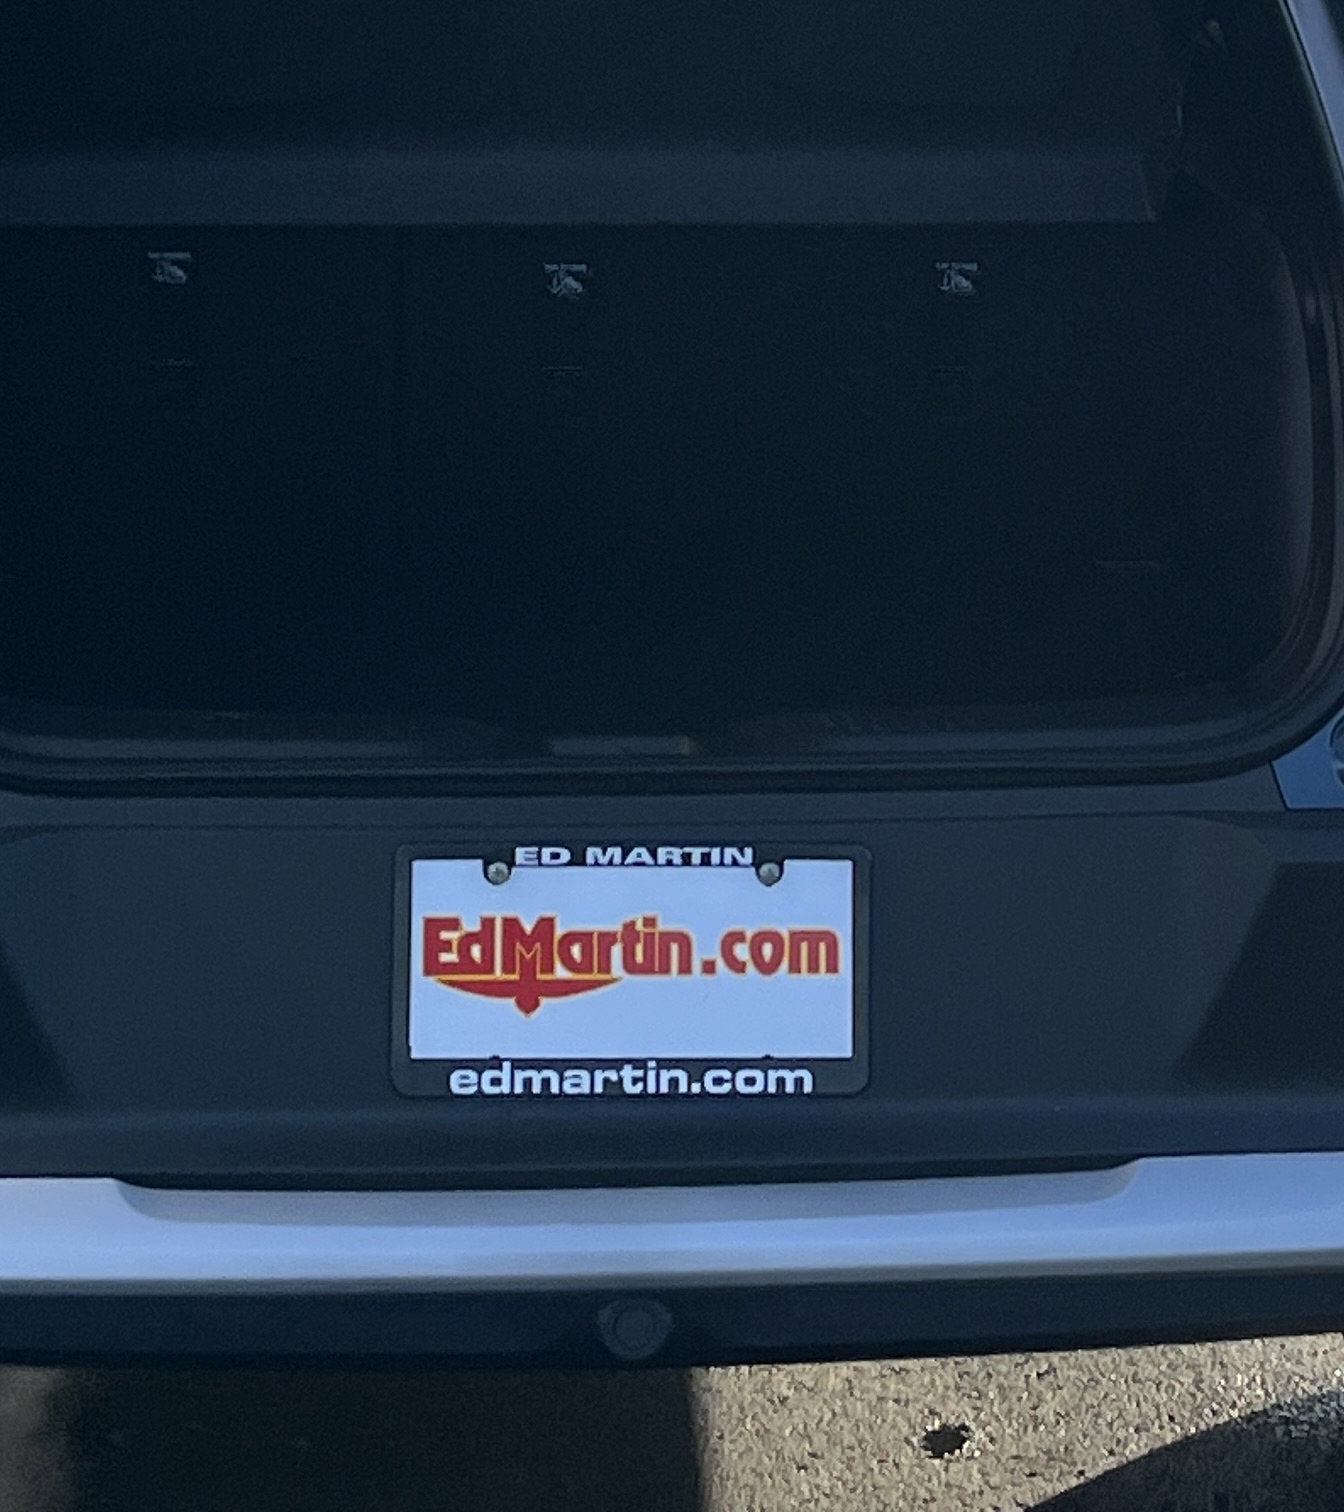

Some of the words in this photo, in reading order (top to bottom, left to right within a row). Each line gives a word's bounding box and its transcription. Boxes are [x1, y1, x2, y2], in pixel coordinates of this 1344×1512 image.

[514, 846, 571, 865] ED
[585, 846, 753, 865] MARTIN
[422, 915, 840, 976] EdMartin.com
[449, 1060, 814, 1095] edmartin.com
